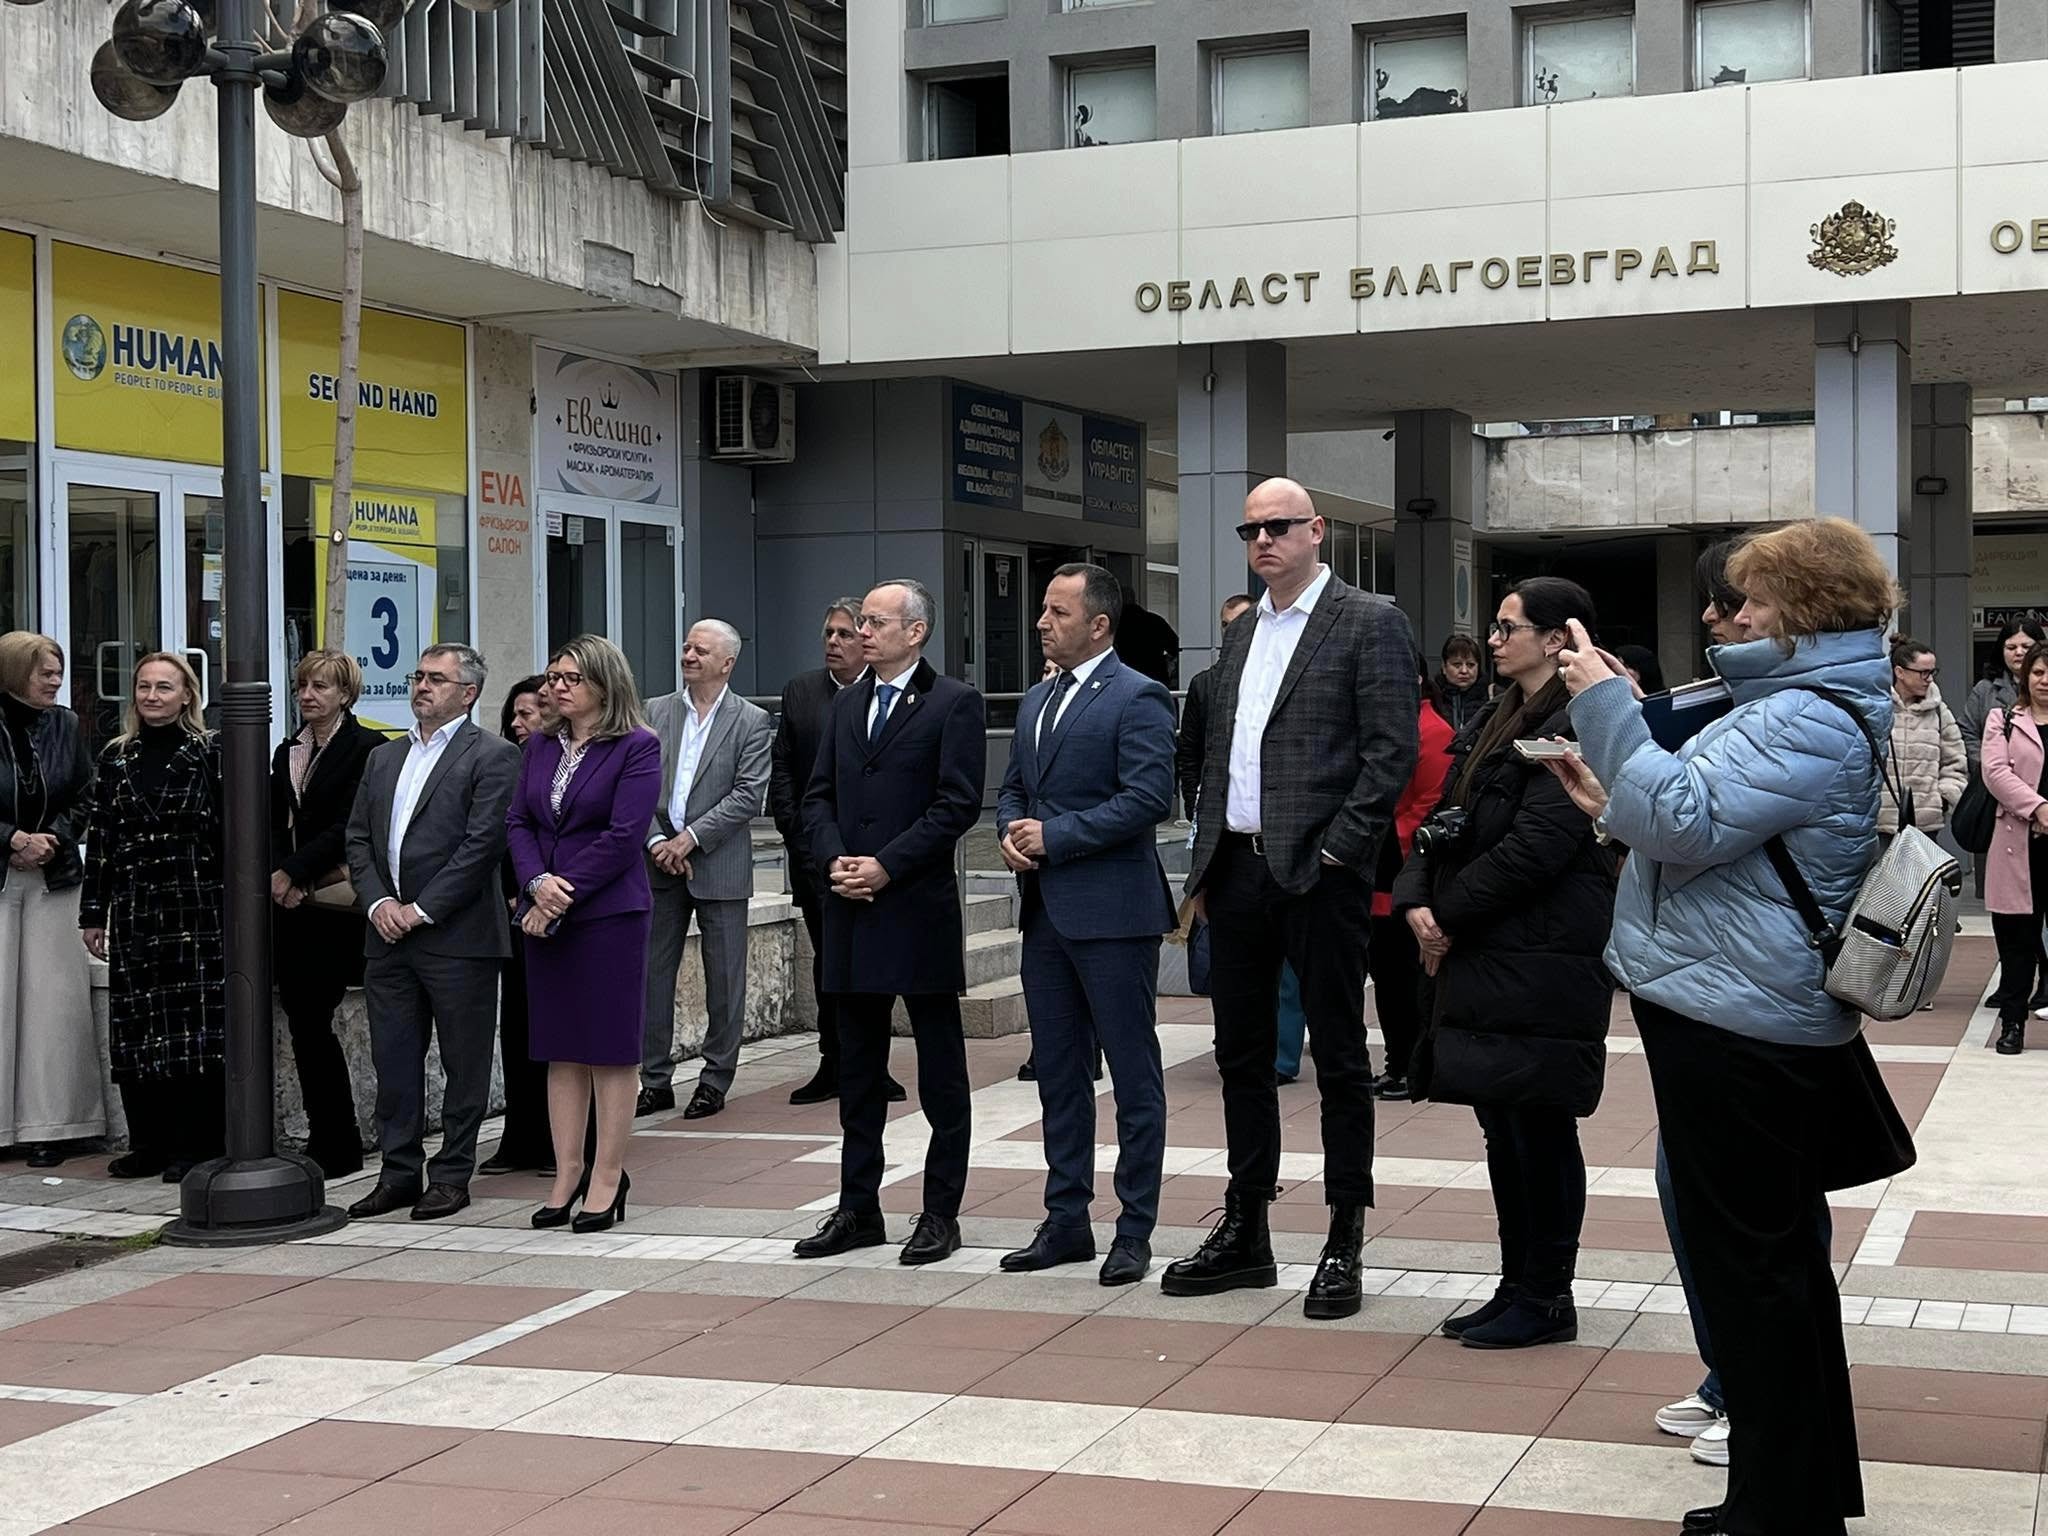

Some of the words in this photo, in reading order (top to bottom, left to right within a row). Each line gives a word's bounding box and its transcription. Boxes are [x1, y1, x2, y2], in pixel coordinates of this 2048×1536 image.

[1135, 272, 1320, 313] ОБЛАСТ
[1349, 240, 1720, 299] БЛАГОЕВГРАД
[113, 324, 223, 380] HUMAN
[115, 372, 151, 389] PEOPLE
[155, 378, 166, 391] TO
[168, 379, 203, 397] PEOPLE
[309, 373, 383, 409] SEND
[389, 387, 438, 418] HAND
[566, 396, 653, 447] Евелина
[970, 403, 1009, 423] ОБЛАСТНА
[621, 449, 648, 464] УСЛУГИ
[964, 437, 1015, 461] БЛАГОЕВГРАД
[1090, 438, 1135, 462] ОБЛАСТЕН
[566, 459, 595, 474] МАСАЖ
[600, 464, 654, 482] АРОМАТЕРАПИЯ
[1088, 460, 1136, 485] УПРАВИТЕЛ
[481, 470, 525, 508] EVA
[355, 500, 418, 527] HUMANA
[488, 536, 522, 555] САЛОН
[370, 570, 380, 581] за
[382, 571, 407, 584] деня:
[371, 596, 399, 670] 3
[356, 656, 368, 669] до
[373, 684, 384, 696] за
[386, 682, 409, 698] брой
